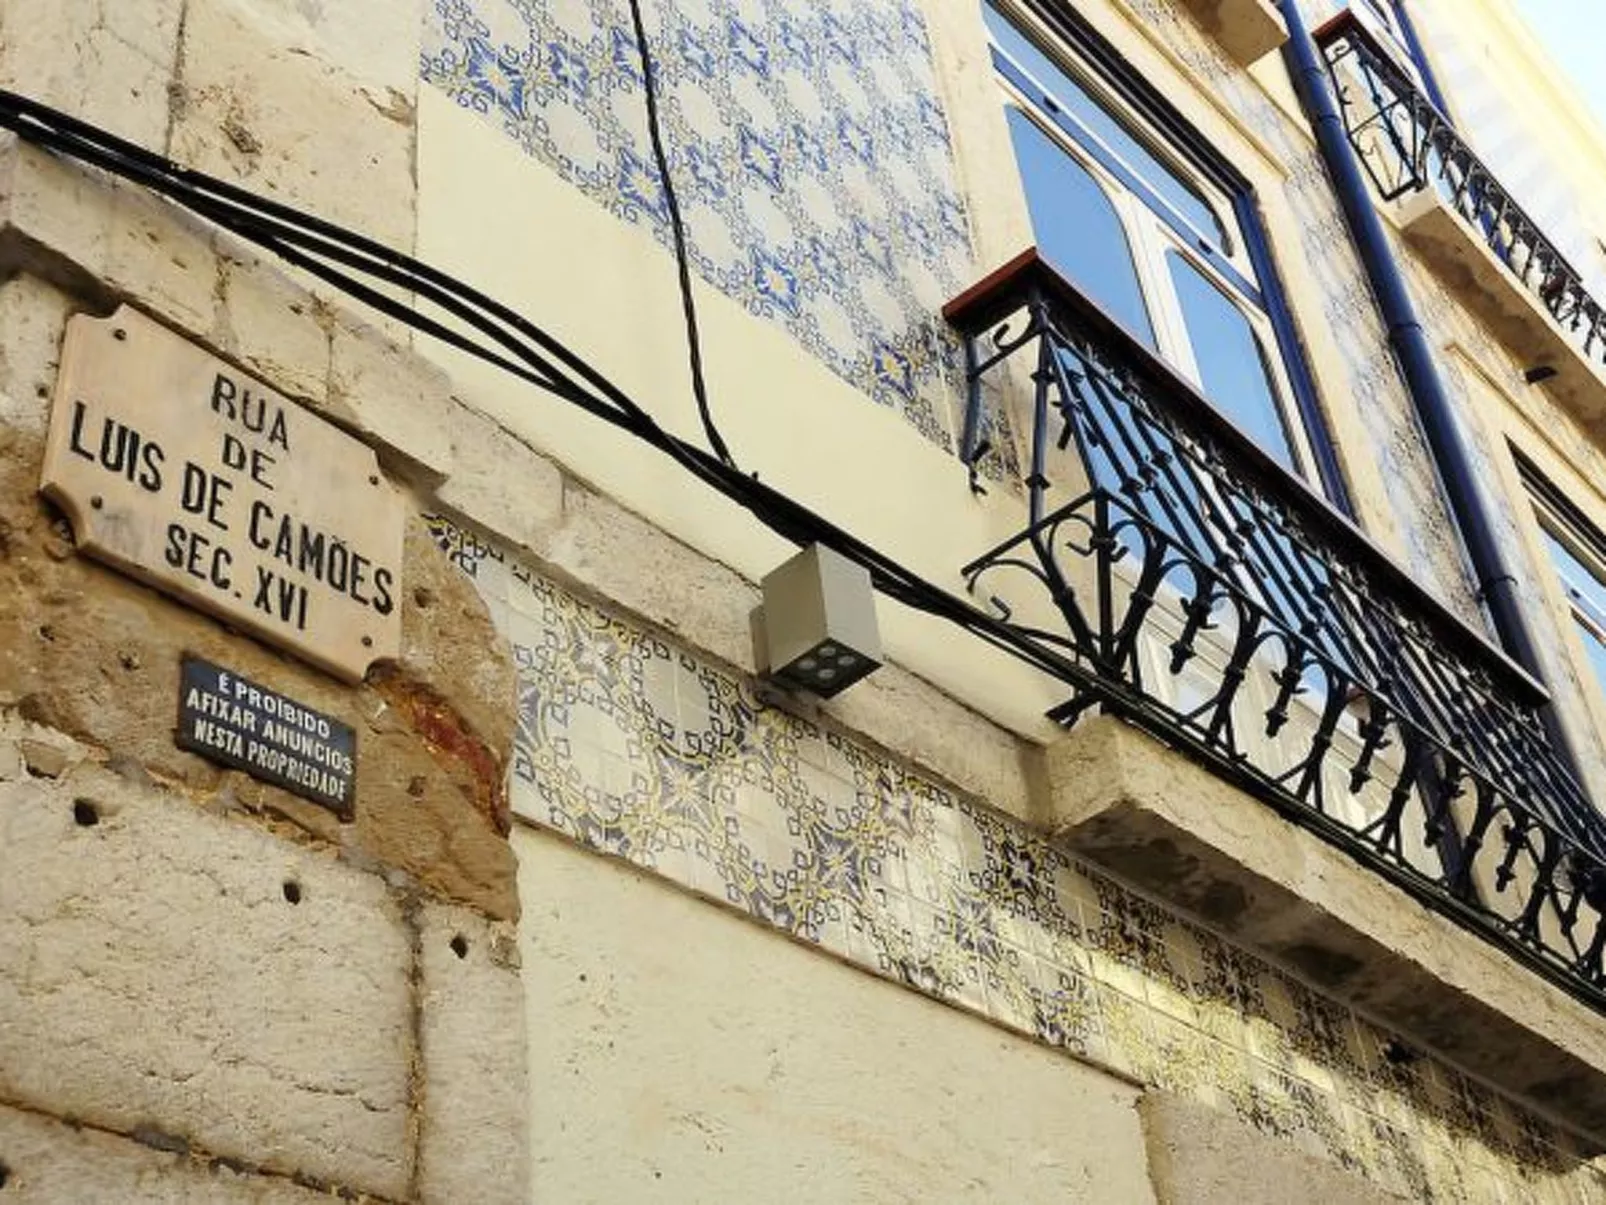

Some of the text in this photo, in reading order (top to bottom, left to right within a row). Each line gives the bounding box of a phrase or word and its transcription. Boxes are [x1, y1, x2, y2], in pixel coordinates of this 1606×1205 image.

[211, 373, 289, 451] RUA
[222, 434, 276, 490] DE
[70, 401, 394, 616] LUIS DE CAMÕES
[165, 524, 308, 630] SEC. XVI
[218, 672, 230, 694] É
[187, 688, 353, 775] AFIXAR ANUNCIOS
[195, 718, 347, 801] NESTA PROPRIEDADE
